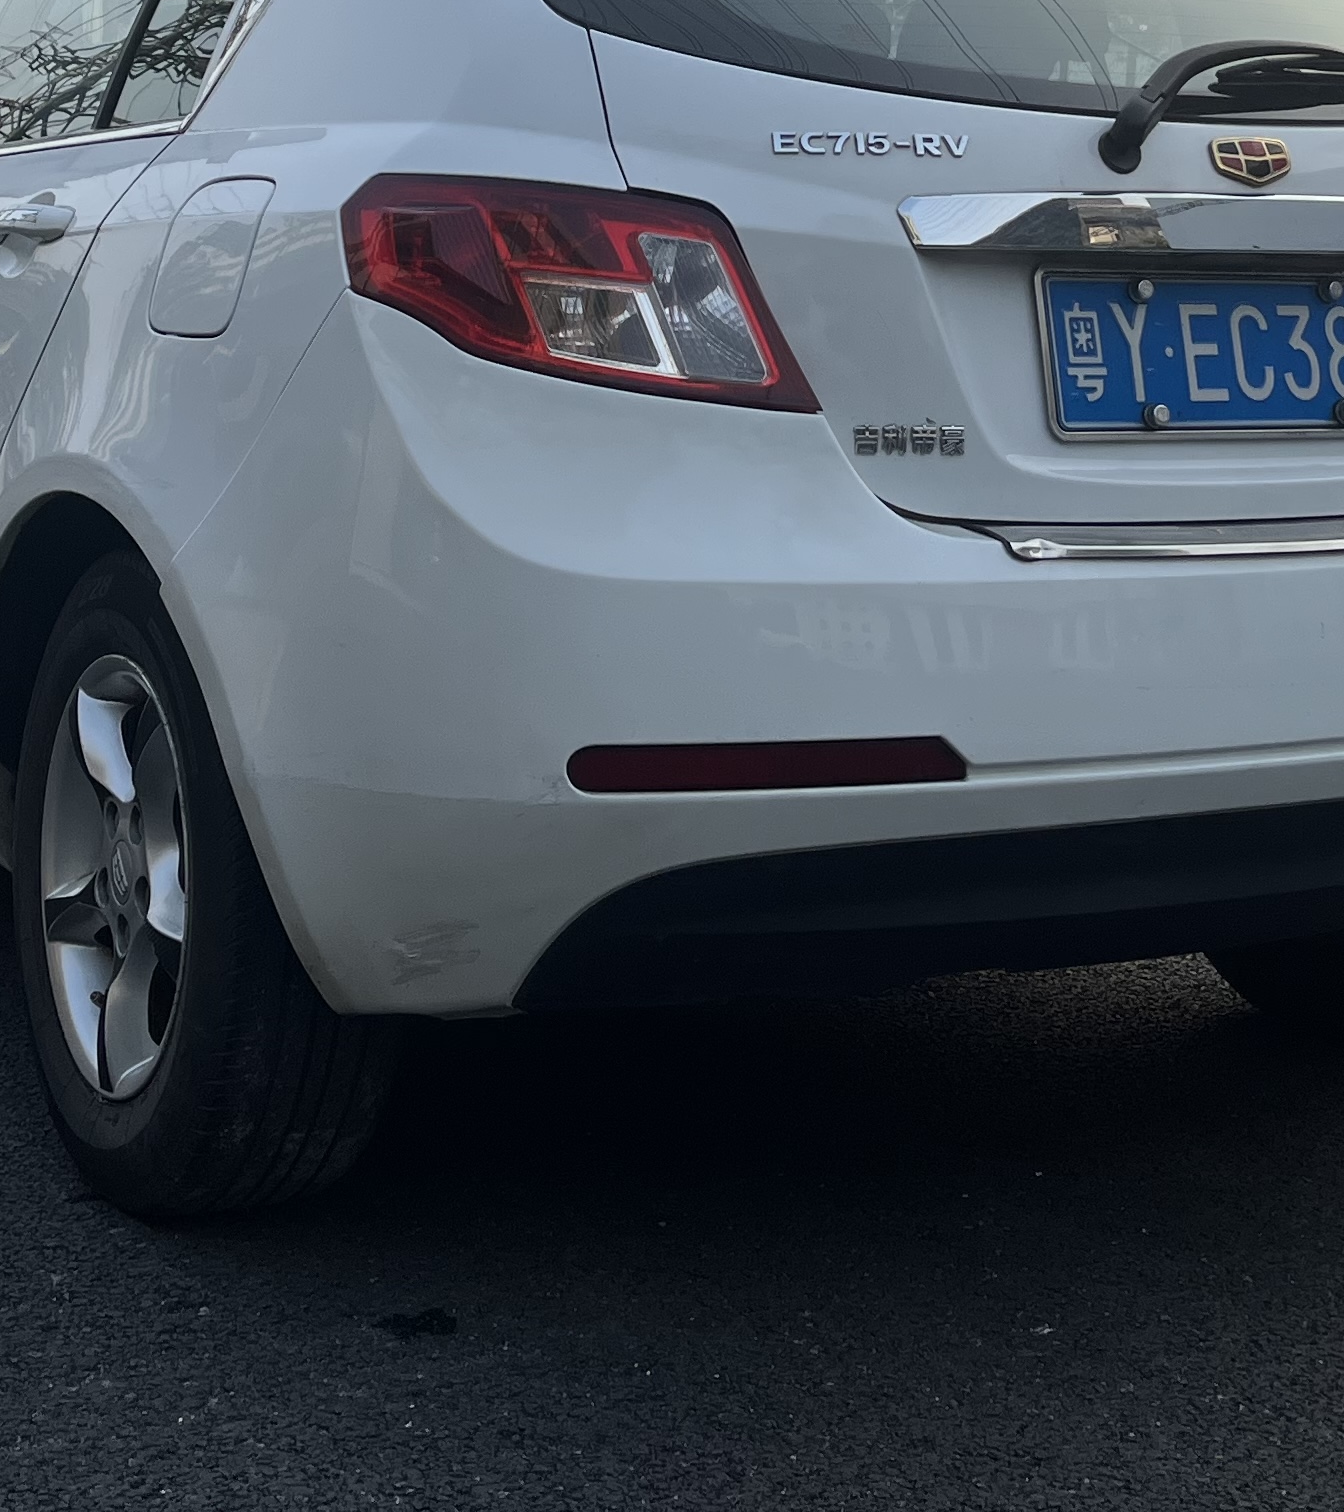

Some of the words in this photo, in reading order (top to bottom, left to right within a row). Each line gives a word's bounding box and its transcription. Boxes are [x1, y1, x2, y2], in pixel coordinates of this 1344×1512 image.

[771, 131, 970, 158] EC715-RV
[853, 423, 965, 457] 吉利帝豪
